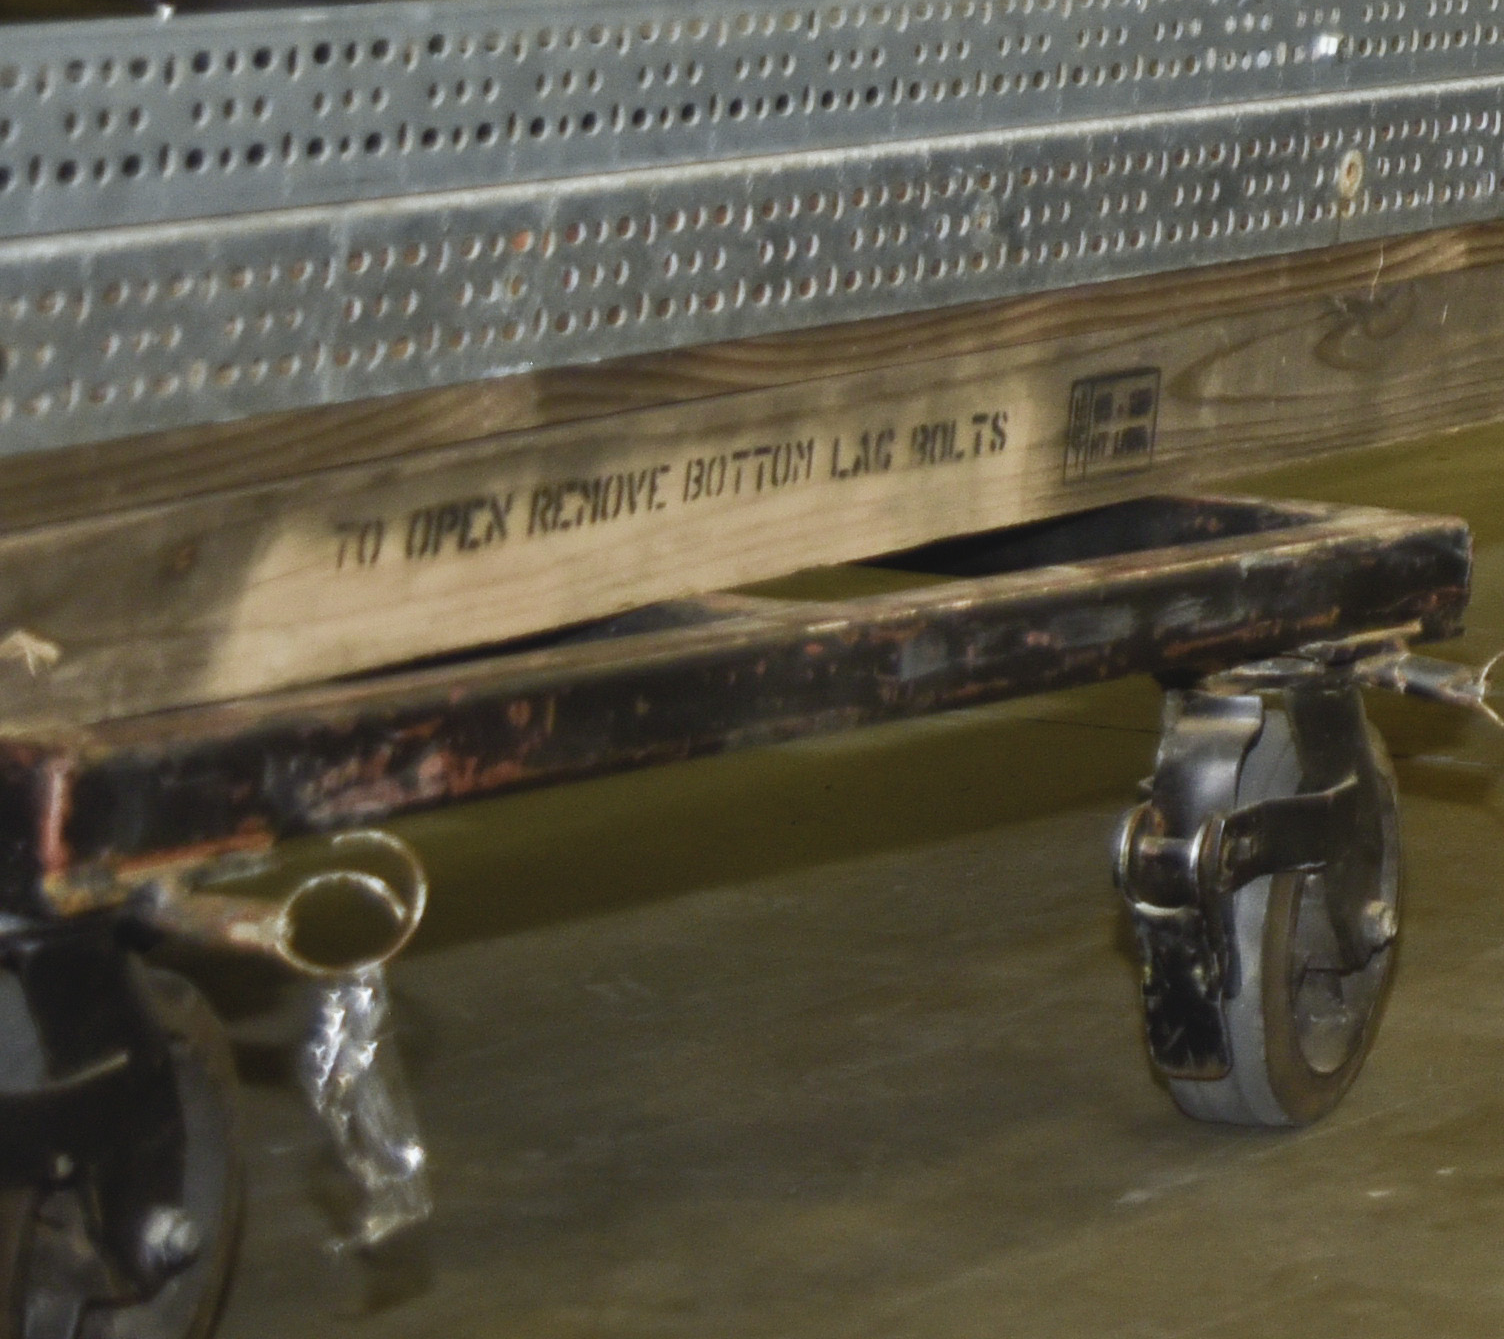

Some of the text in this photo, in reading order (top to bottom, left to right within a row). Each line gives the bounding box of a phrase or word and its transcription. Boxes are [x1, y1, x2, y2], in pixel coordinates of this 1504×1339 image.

[334, 520, 386, 569] TO
[528, 463, 671, 538] REMOVE
[682, 436, 815, 503] BOTTOM
[830, 427, 897, 479] LAG
[910, 410, 1009, 465] BOLTS
